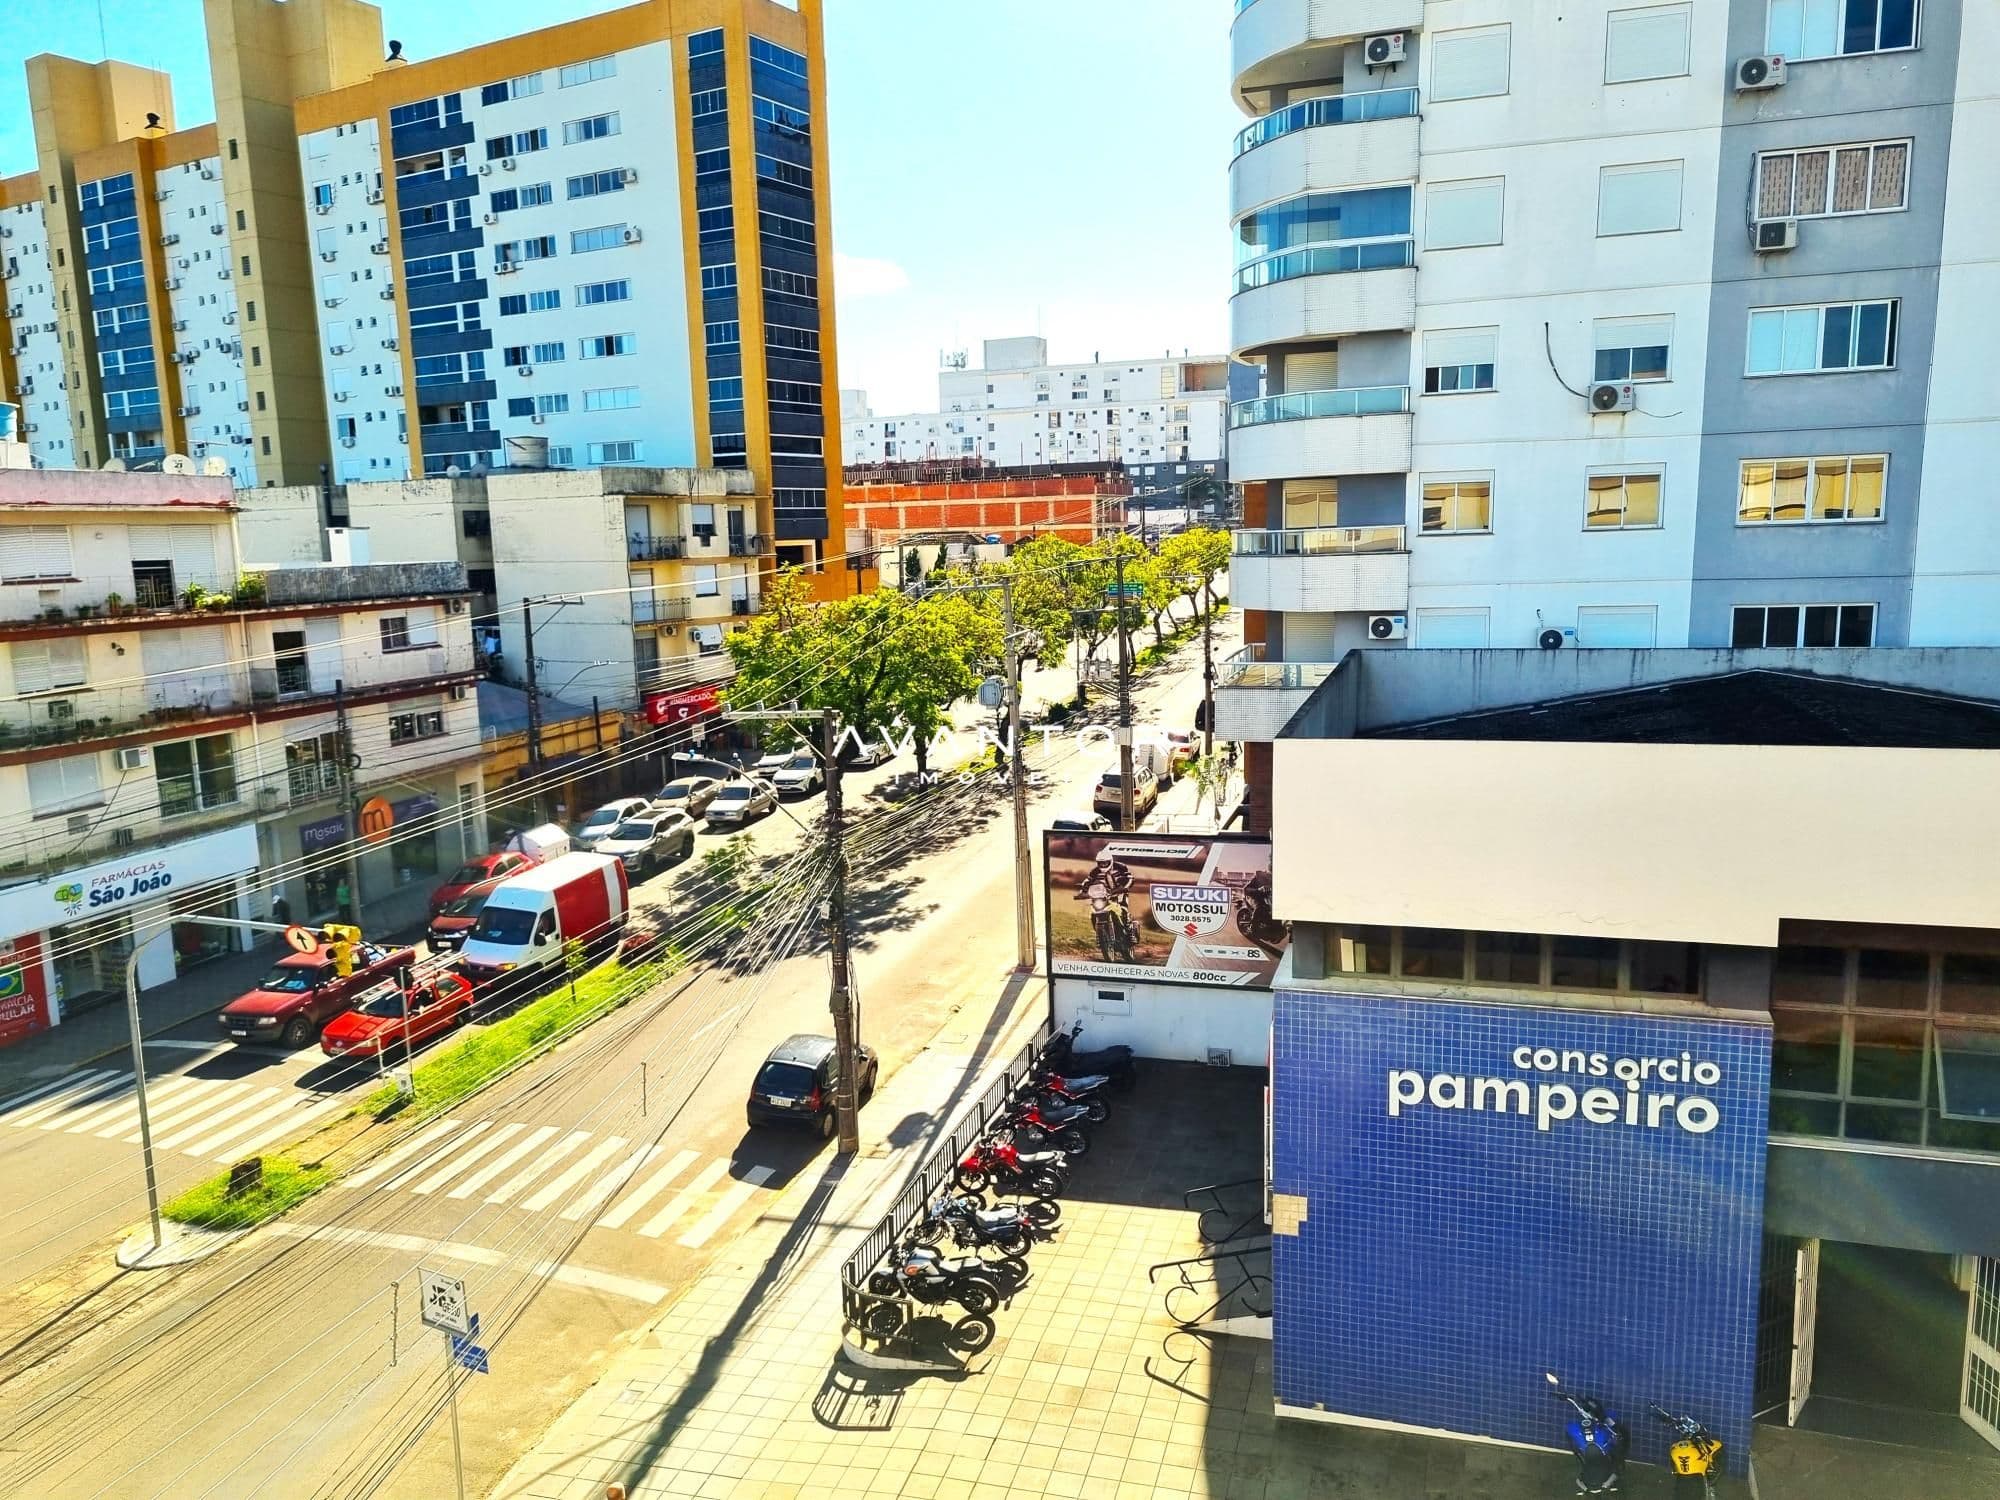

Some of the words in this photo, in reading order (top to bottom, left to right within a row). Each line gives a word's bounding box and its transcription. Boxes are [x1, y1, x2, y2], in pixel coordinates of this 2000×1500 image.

[89, 884, 125, 907] São
[129, 866, 172, 896] João
[91, 861, 166, 888] FARMÁCIAS
[1153, 887, 1228, 902] SUZUKI
[1155, 902, 1227, 915] MOTOSSUL
[1058, 963, 1089, 972] VENHA
[1090, 965, 1142, 976] CONHECER
[1143, 969, 1156, 977] AS
[1158, 970, 1190, 979] NOVAS
[1192, 971, 1227, 982] 800cc
[1513, 1046, 1721, 1085] consorcio
[1388, 1069, 1720, 1133] pampeiro
